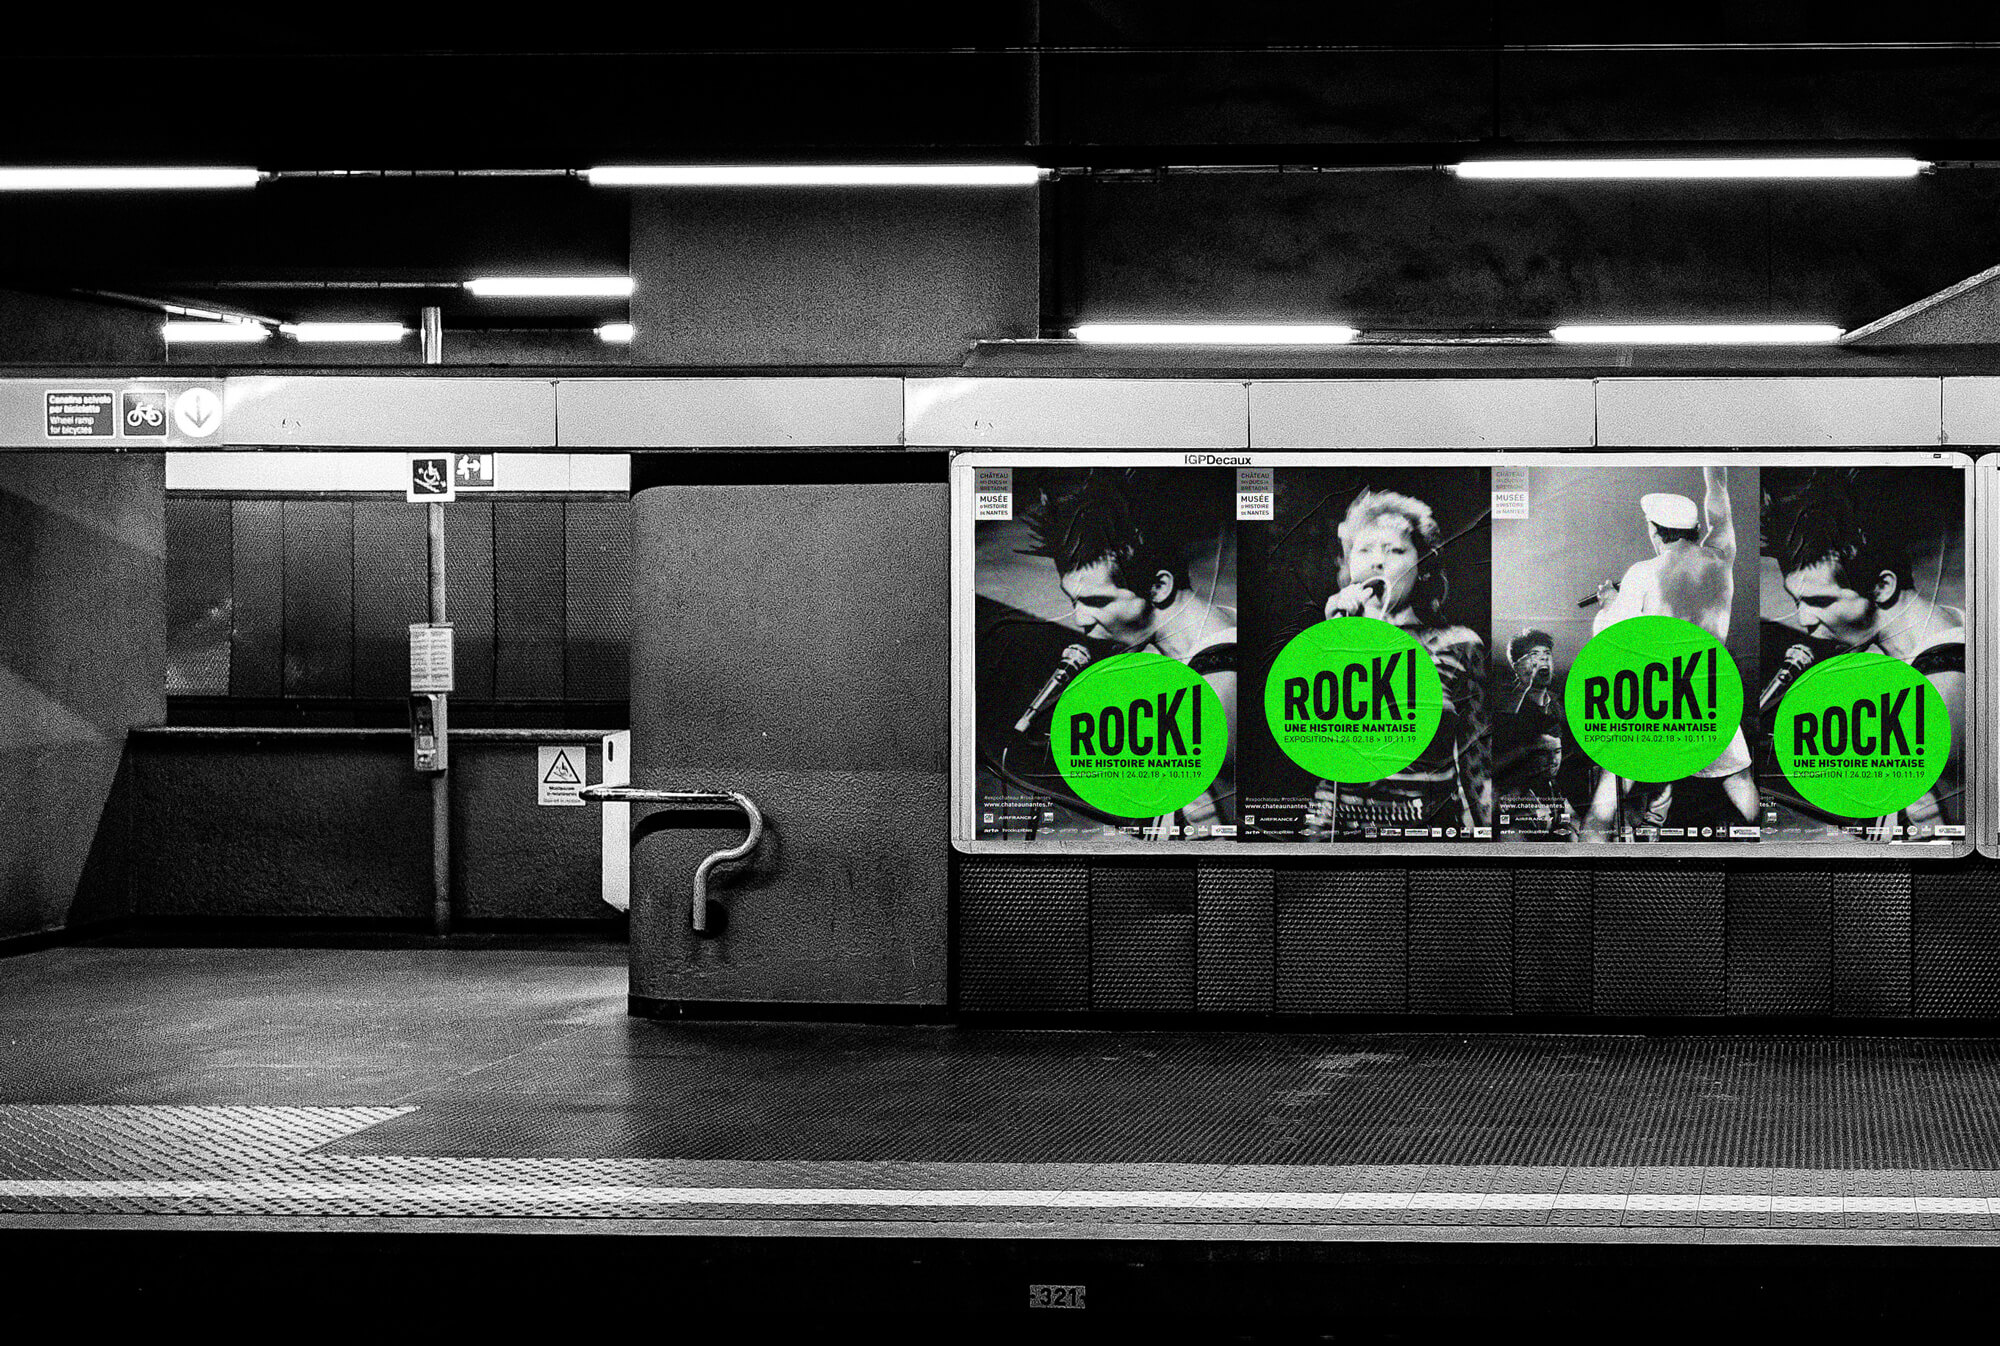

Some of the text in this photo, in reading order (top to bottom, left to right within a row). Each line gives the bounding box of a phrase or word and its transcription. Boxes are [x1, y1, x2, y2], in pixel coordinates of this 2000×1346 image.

[50, 416, 95, 426] Wheel ramp
[1184, 454, 1252, 465] IGPDecaux
[980, 494, 1008, 503] MUSÉE
[1241, 494, 1269, 503] MUSÉE
[1285, 649, 1416, 721] ROCK!
[1585, 648, 1716, 720] ROCK!
[1071, 684, 1202, 756] ROCK!
[1794, 684, 1925, 756] ROCK!
[1285, 724, 1416, 732] UNE HISTOIRE NANTAISE
[1585, 723, 1716, 731] UNE HISTOIRE NANTAISE
[1071, 759, 1202, 767] UNE HISTOIRE NANTAISE
[1794, 759, 1925, 767] UNE HISTOIRE NANTAISE
[1040, 1288, 1077, 1306] 321
